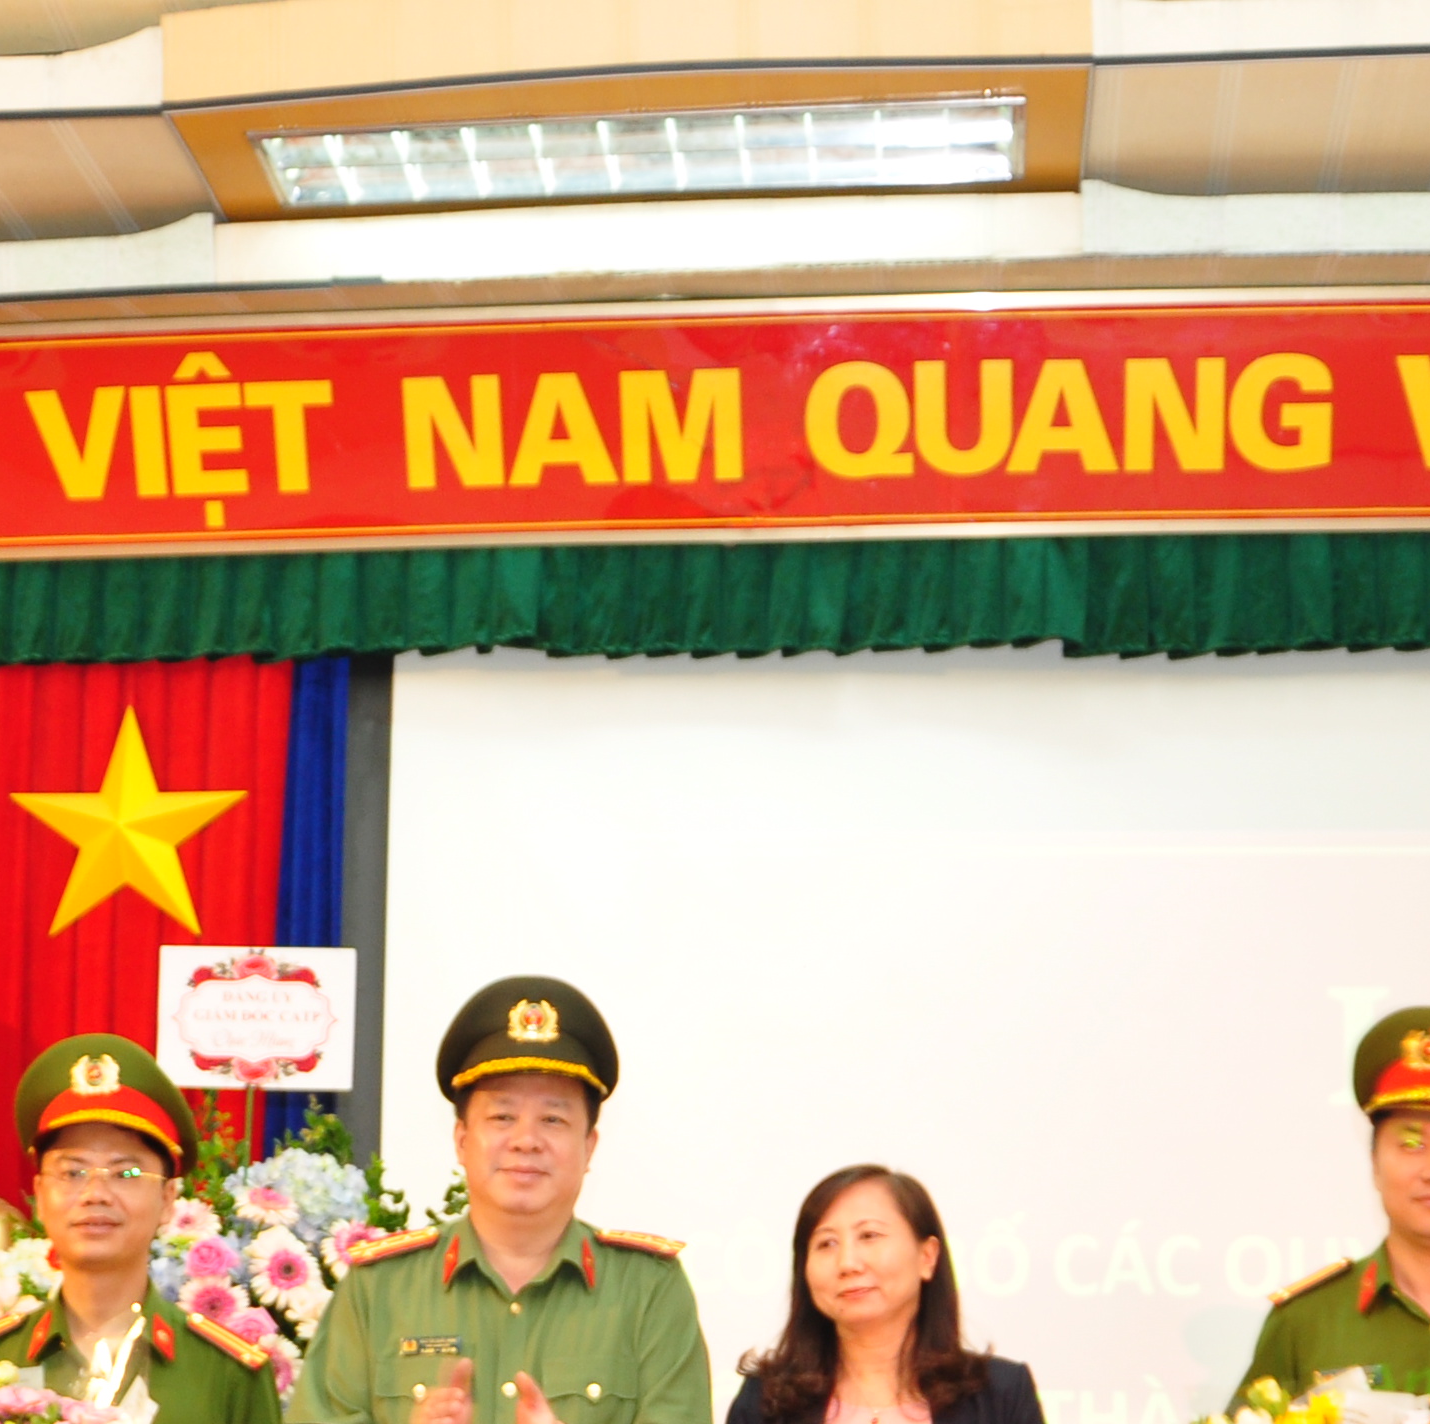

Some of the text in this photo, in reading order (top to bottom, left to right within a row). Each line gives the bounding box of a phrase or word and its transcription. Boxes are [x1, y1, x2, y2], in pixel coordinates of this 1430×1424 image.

[24, 351, 334, 530] VIỆT
[401, 367, 745, 491] NAM
[804, 352, 1334, 481] QUANG
[1053, 1220, 1200, 1298] CÁC
